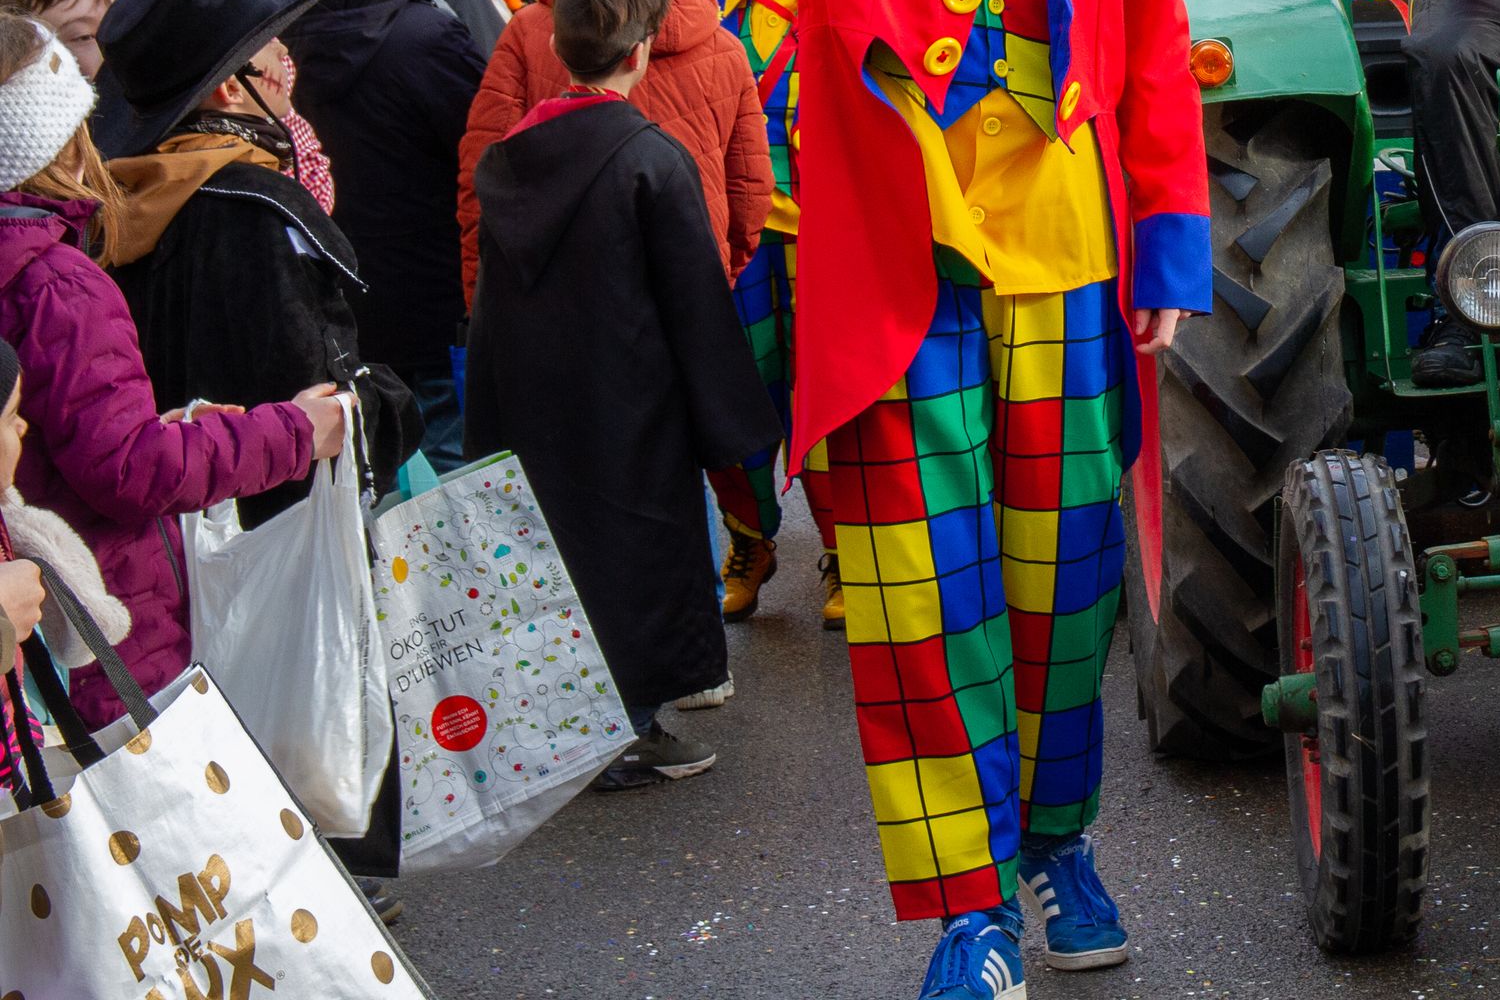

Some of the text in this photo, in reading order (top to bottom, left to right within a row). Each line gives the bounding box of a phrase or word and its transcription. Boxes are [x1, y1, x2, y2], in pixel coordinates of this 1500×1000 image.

[390, 609, 466, 660] ÖKO-TUT
[429, 639, 448, 653] FIR
[396, 638, 484, 693] D'LIEWEN
[117, 853, 232, 983] POMP
[145, 918, 276, 1000] UX
